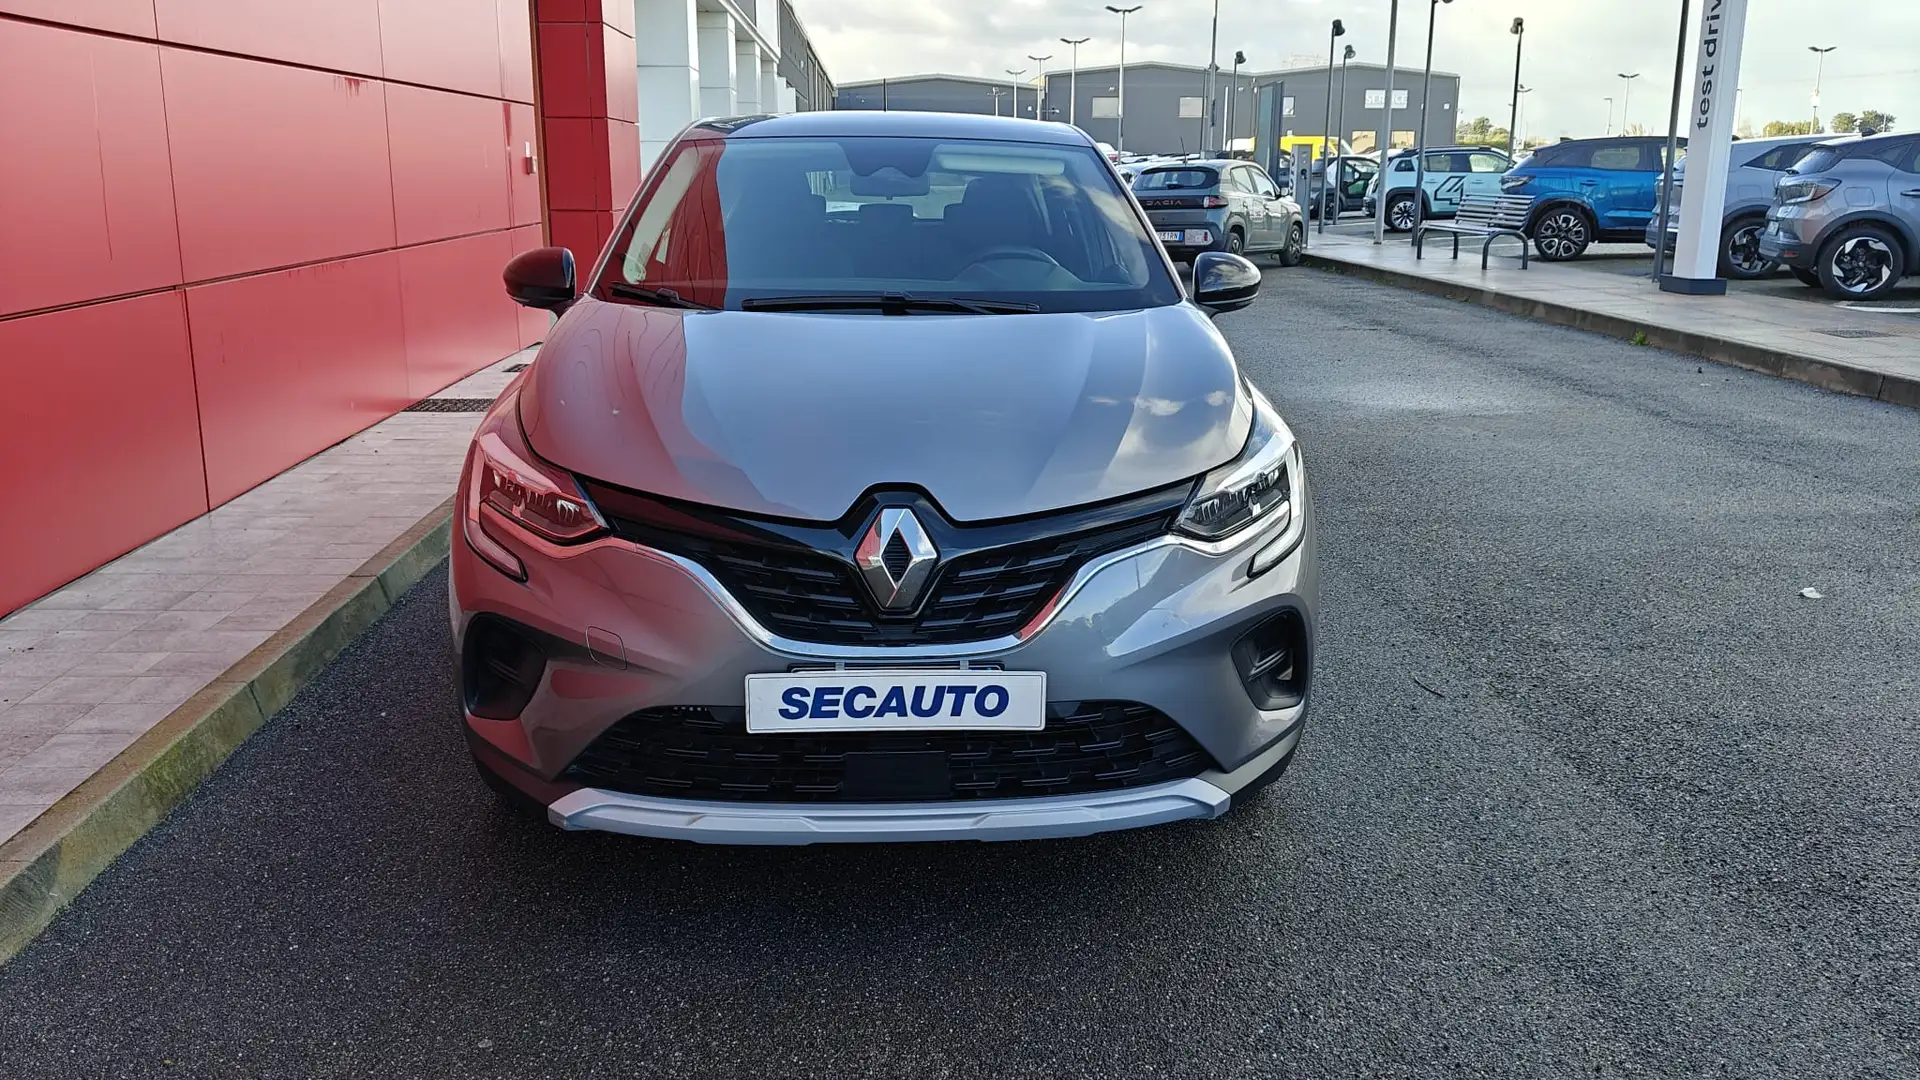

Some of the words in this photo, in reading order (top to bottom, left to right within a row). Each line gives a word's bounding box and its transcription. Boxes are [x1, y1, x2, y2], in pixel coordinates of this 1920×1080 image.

[1365, 94, 1407, 105] SERICE
[1696, 64, 1715, 131] test
[778, 684, 1010, 720] SECAUTO
